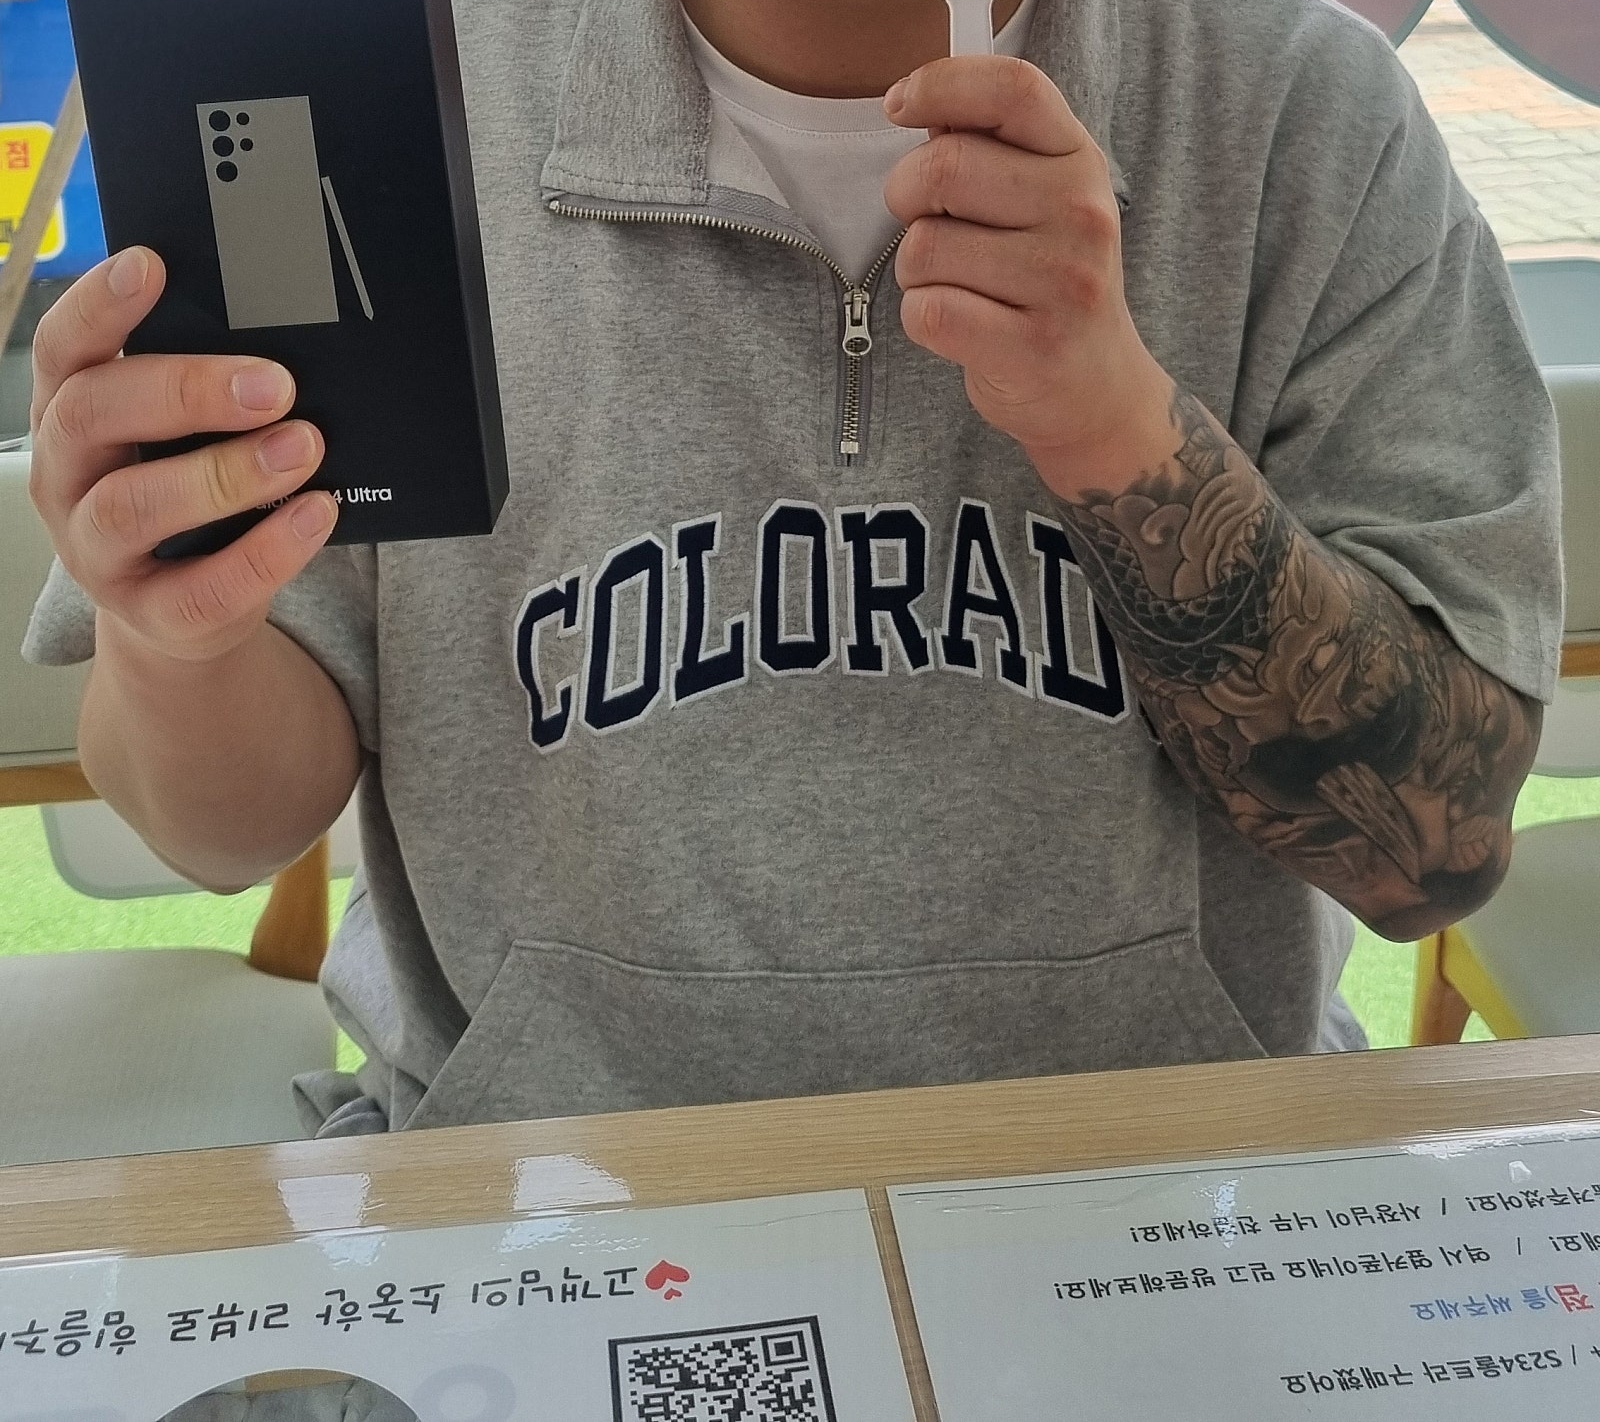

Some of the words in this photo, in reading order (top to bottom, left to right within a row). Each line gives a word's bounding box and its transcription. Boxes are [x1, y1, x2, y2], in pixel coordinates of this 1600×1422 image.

[346, 486, 393, 505] Ultra
[512, 496, 1160, 755] COLORAD
[1269, 1211, 1319, 1233] 너무
[1325, 1203, 1420, 1229] 사장님이
[1281, 1249, 1433, 1279] 옆커폰이네요
[1439, 1243, 1491, 1266] 역시
[471, 1266, 638, 1307] 고객님의
[1053, 1266, 1216, 1301] 방문해보세요!
[1223, 1261, 1276, 1284] 믿고
[315, 1281, 446, 1332] 소중한
[1410, 1293, 1512, 1320] 써주세요
[0, 1309, 137, 1356] 힘을주
[167, 1302, 290, 1342] 리뷰로
[1280, 1363, 1414, 1394] 구매했어요
